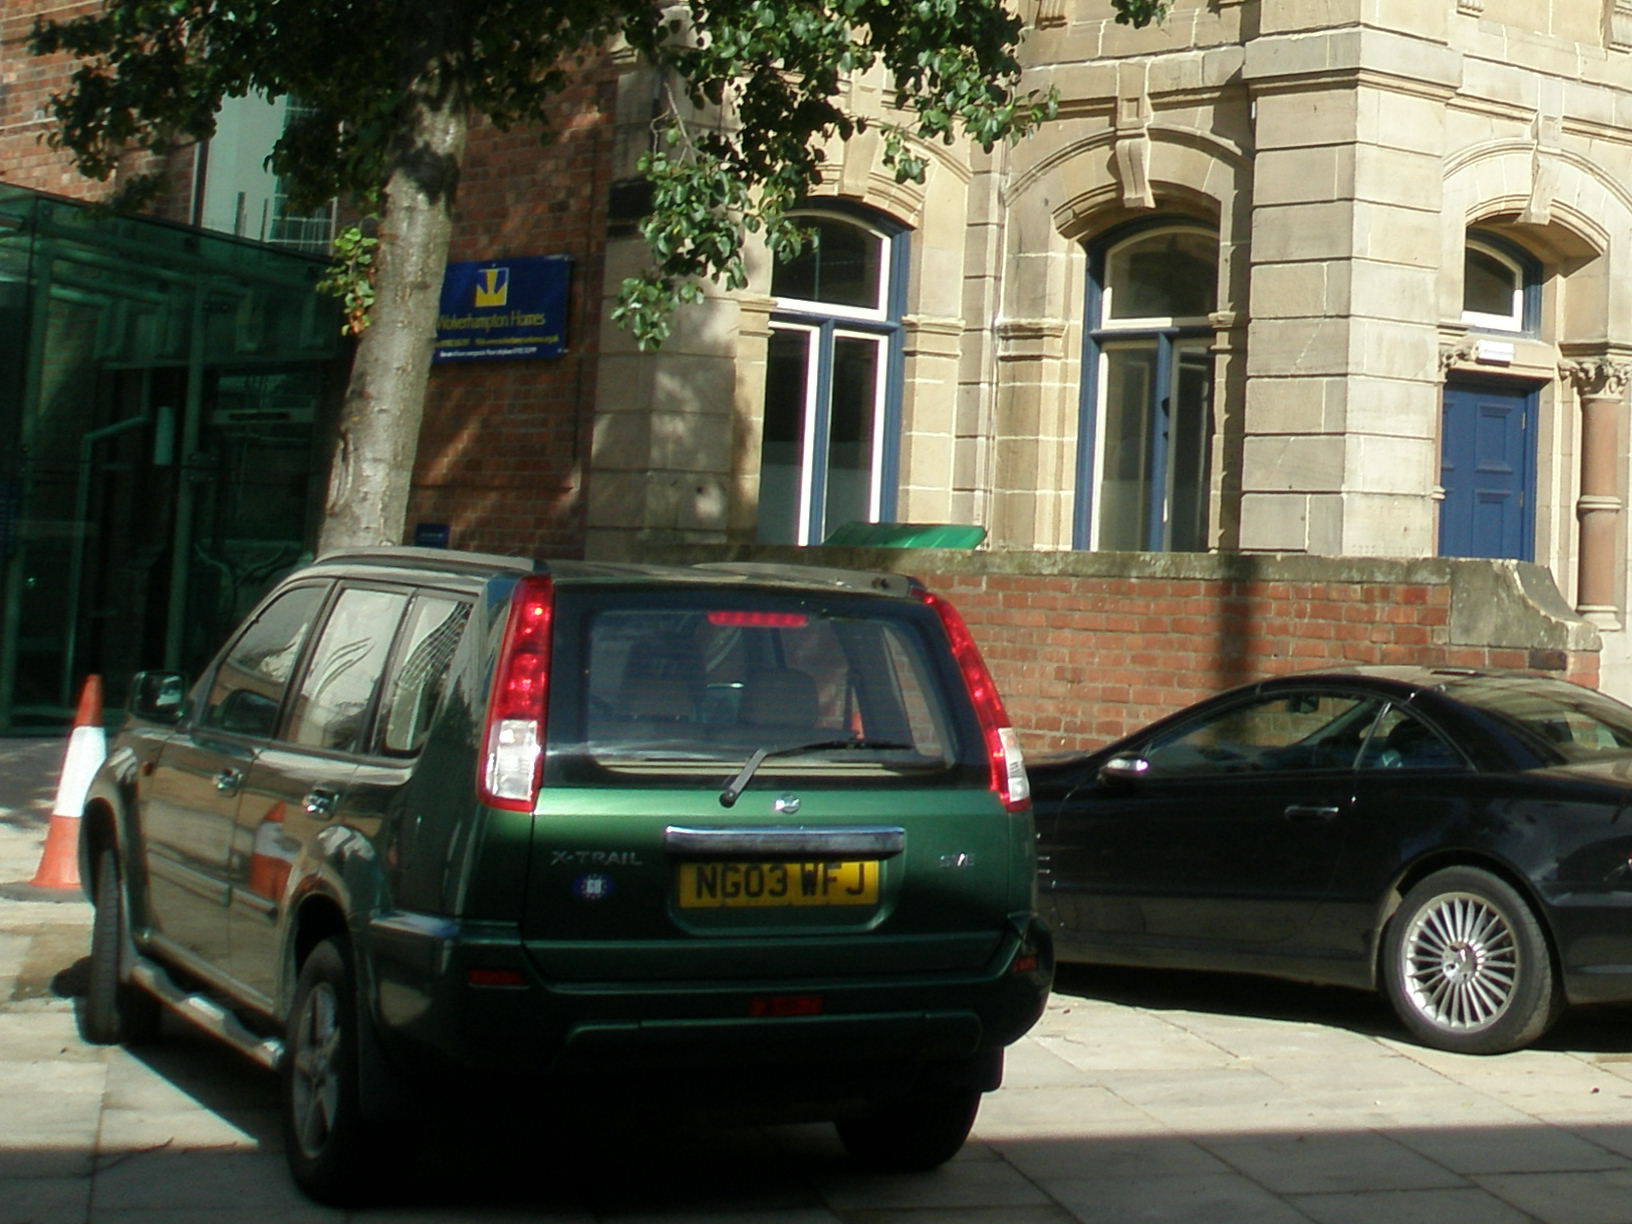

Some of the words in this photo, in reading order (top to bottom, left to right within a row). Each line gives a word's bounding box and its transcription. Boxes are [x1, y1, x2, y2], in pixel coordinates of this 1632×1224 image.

[511, 310, 546, 326] Homes
[549, 850, 643, 866] X-TRAIL
[694, 862, 788, 900] NG03
[800, 862, 866, 897] WFJ
